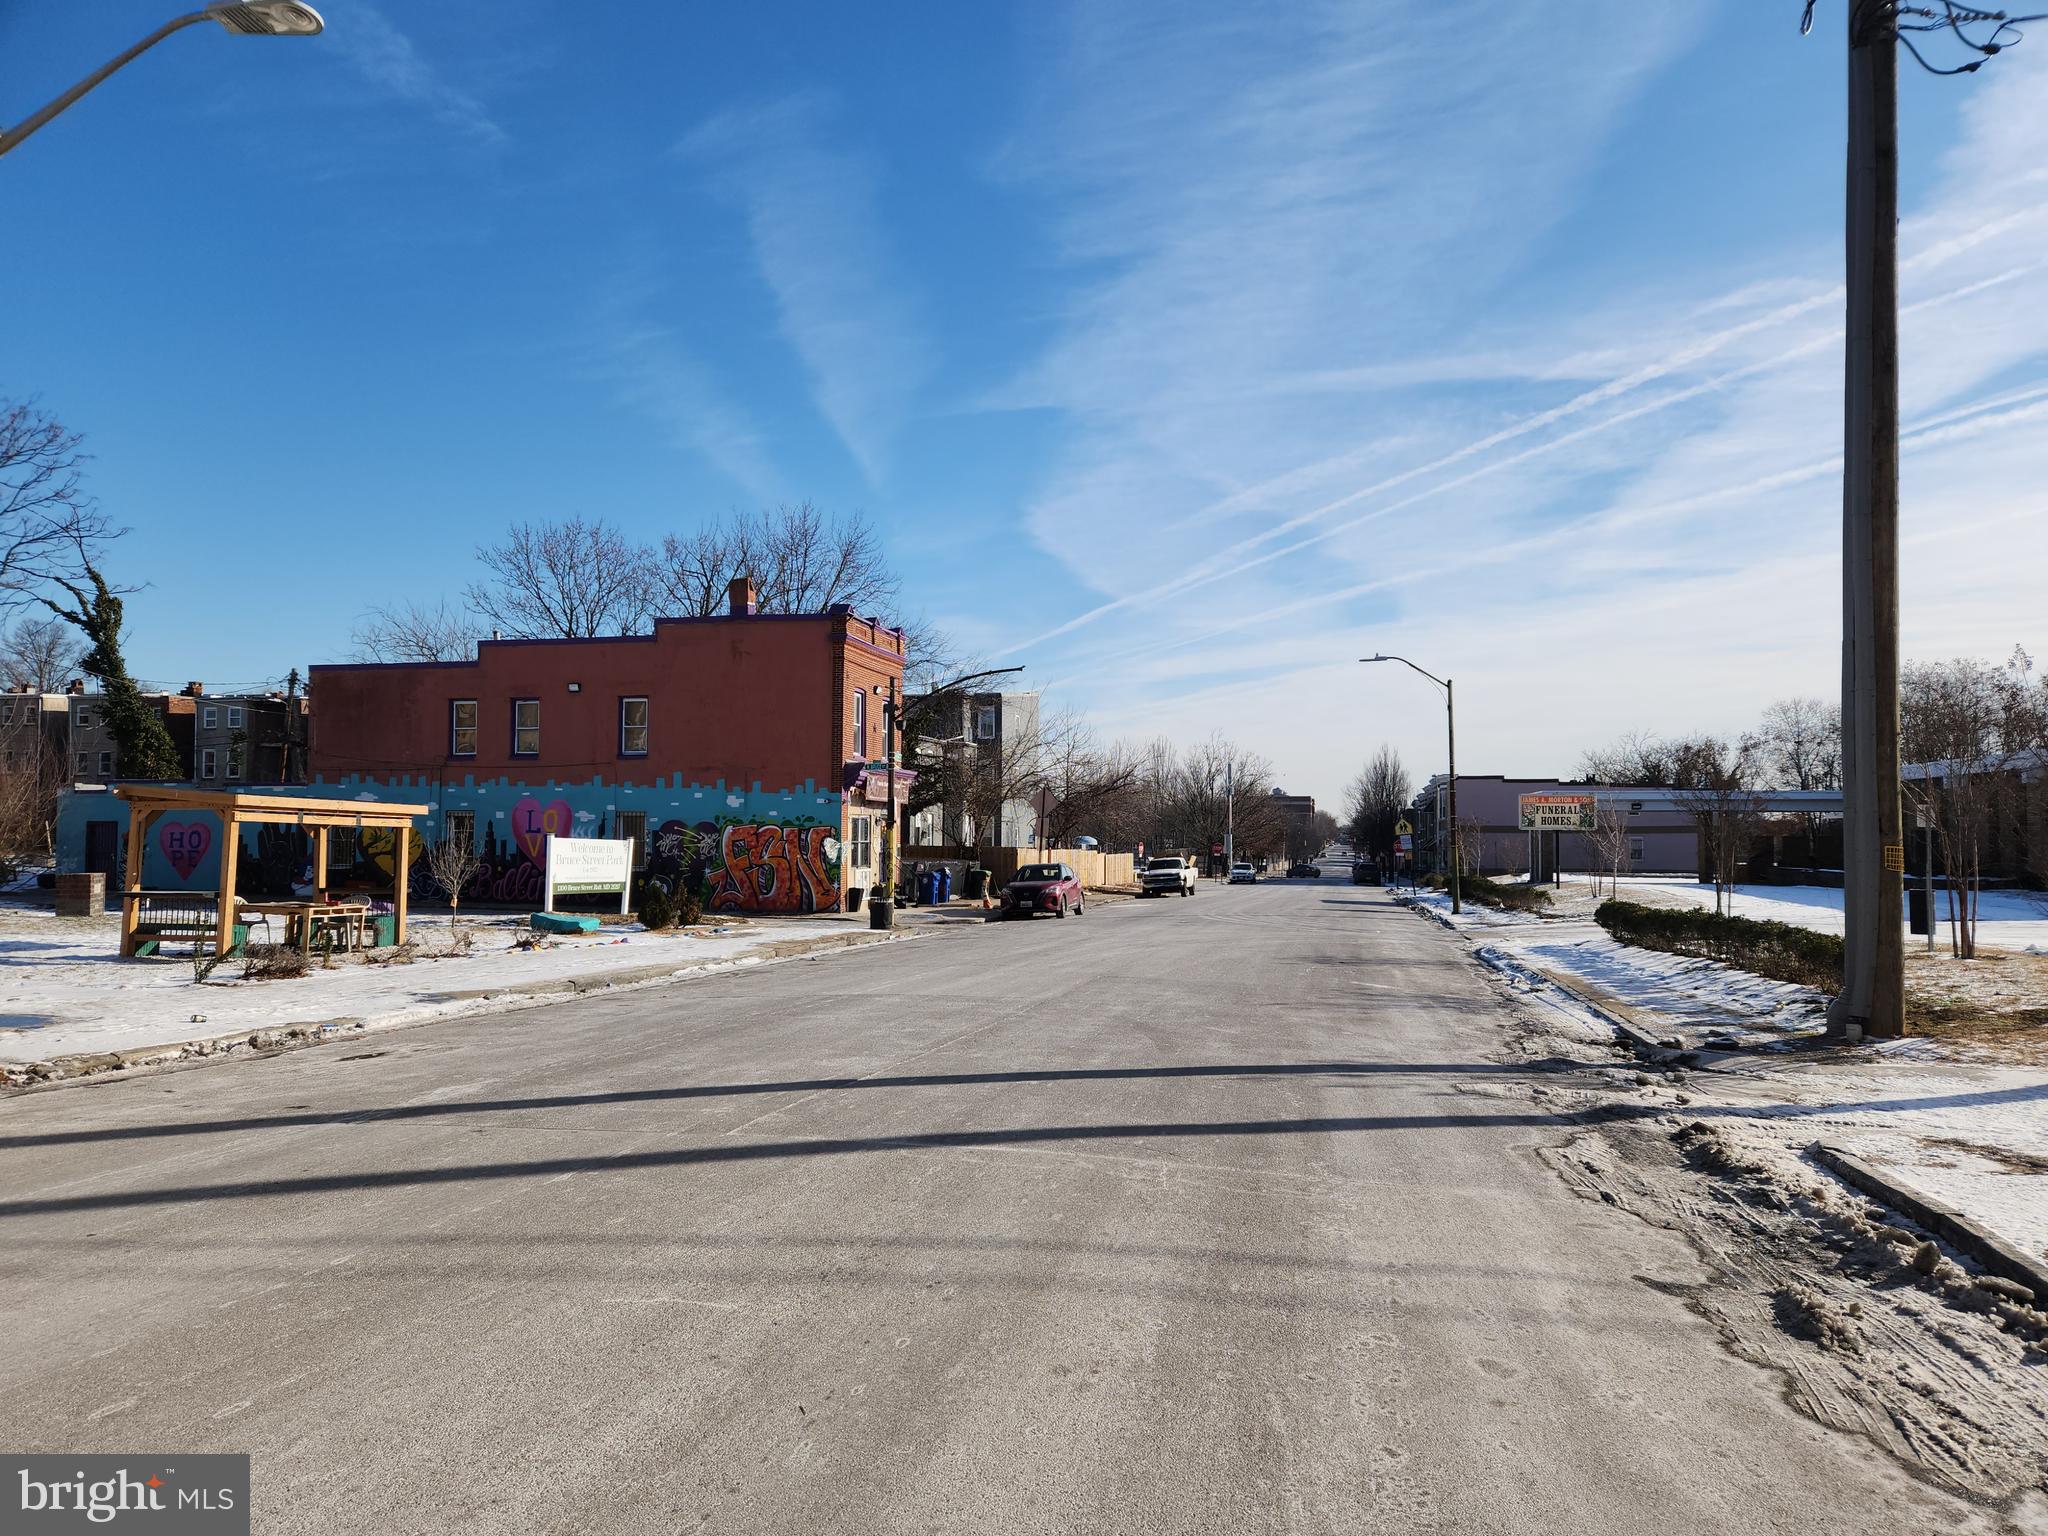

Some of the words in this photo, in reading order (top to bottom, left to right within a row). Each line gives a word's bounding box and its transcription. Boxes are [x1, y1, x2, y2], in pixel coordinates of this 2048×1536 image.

[1535, 805, 1580, 815] FUNERAL
[1540, 816, 1572, 826] HOMES
[570, 842, 605, 854] Welcome
[606, 844, 615, 855] to
[556, 852, 579, 865] Bruce
[581, 853, 605, 865] Street
[606, 854, 624, 865] Park
